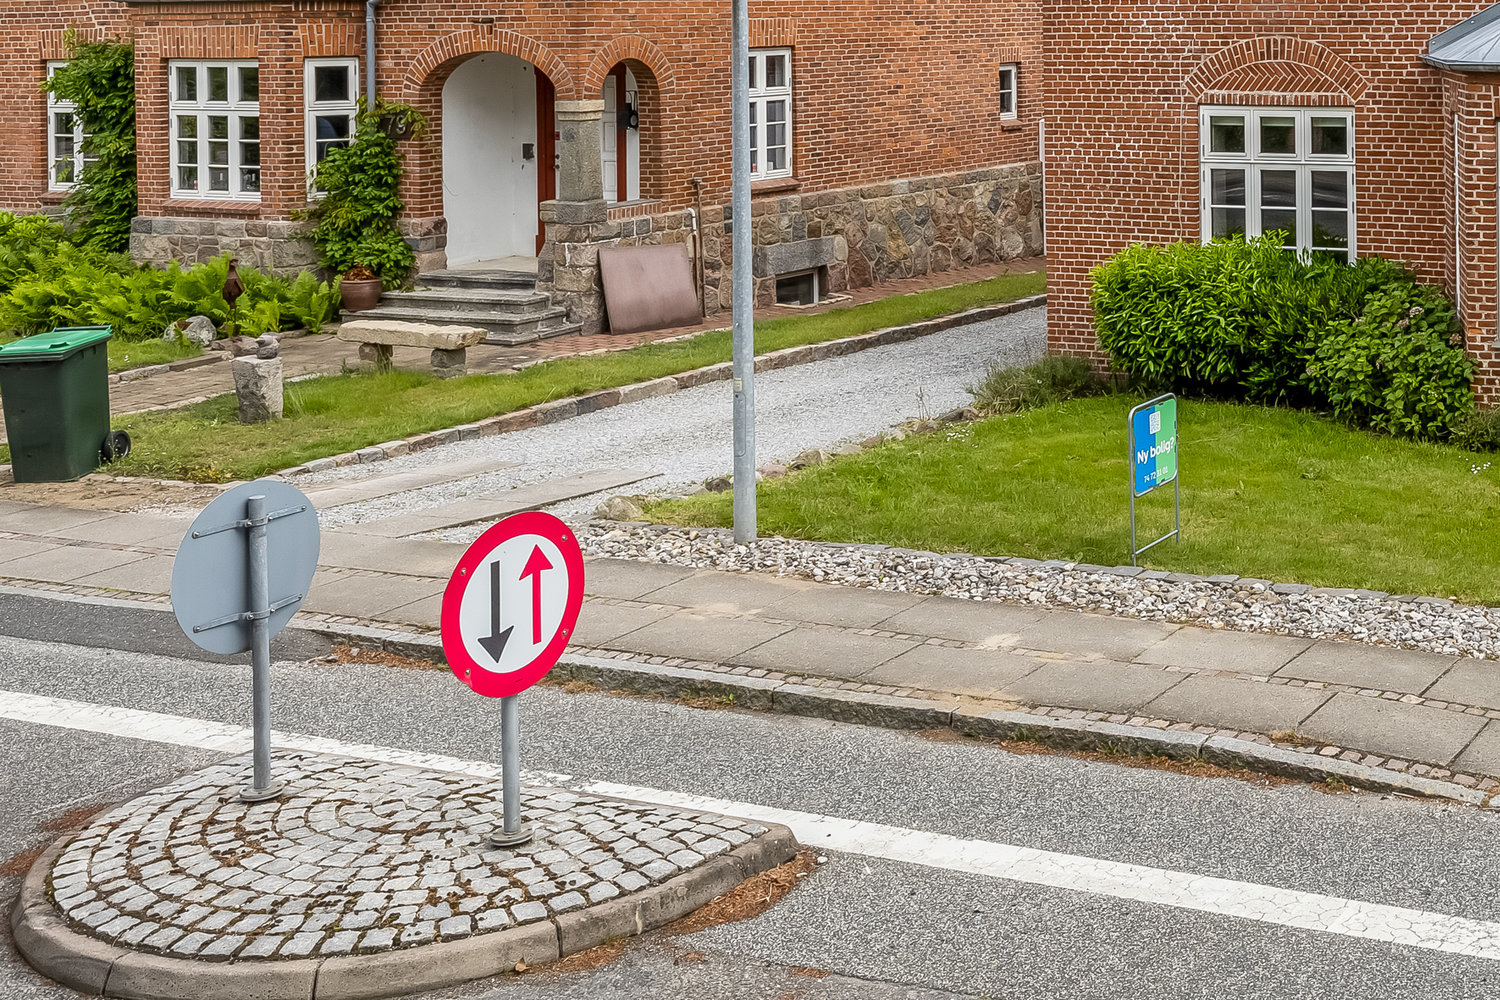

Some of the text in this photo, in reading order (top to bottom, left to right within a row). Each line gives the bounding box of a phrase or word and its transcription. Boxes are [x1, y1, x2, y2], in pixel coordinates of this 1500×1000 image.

[384, 115, 406, 135] 79
[1137, 436, 1175, 464] Ny bolig?
